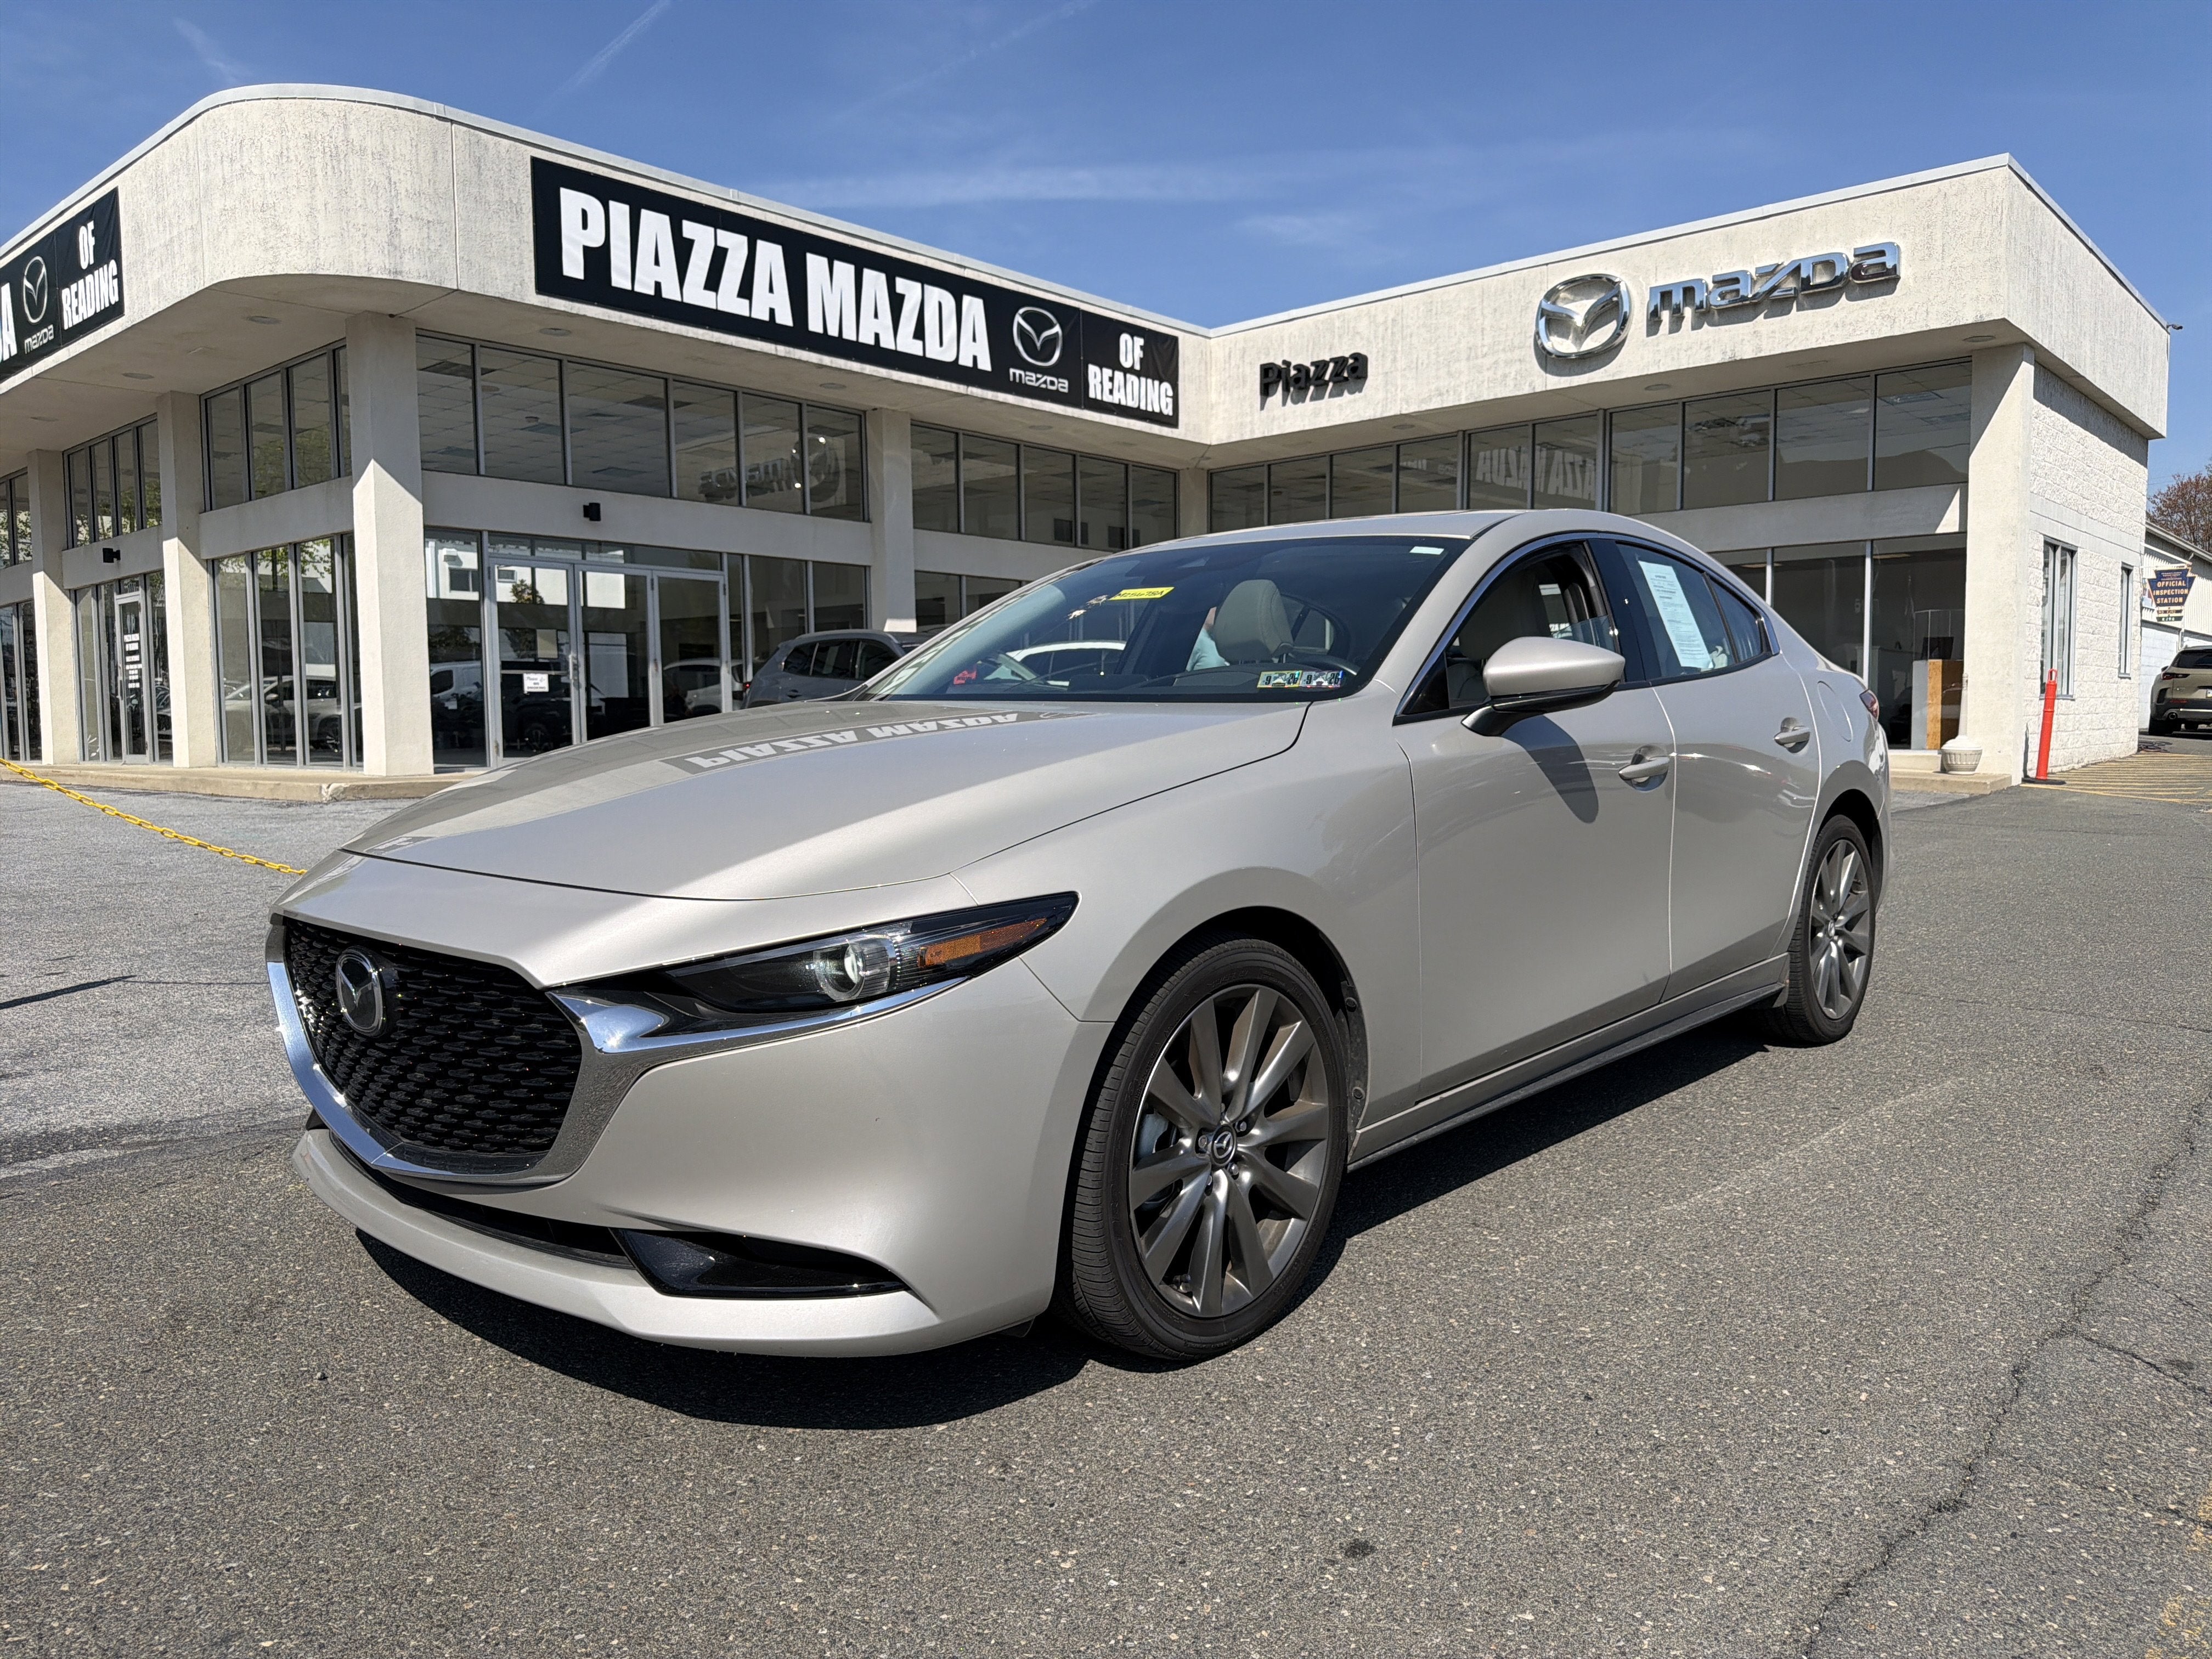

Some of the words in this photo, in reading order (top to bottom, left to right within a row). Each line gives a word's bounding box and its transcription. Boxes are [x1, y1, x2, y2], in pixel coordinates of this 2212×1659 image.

[78, 220, 95, 269] OF
[61, 259, 119, 330] READING
[558, 187, 793, 327] PIAZZA
[805, 252, 992, 372] MAZDA
[1647, 240, 1901, 323] mazda
[24, 324, 54, 354] mazda
[1119, 332, 1144, 371] OF
[1009, 368, 1069, 393] mazda
[1088, 363, 1173, 416] READING
[1260, 352, 1368, 397] Piazza
[1265, 675, 1272, 685] 9
[1306, 674, 1313, 685] 9
